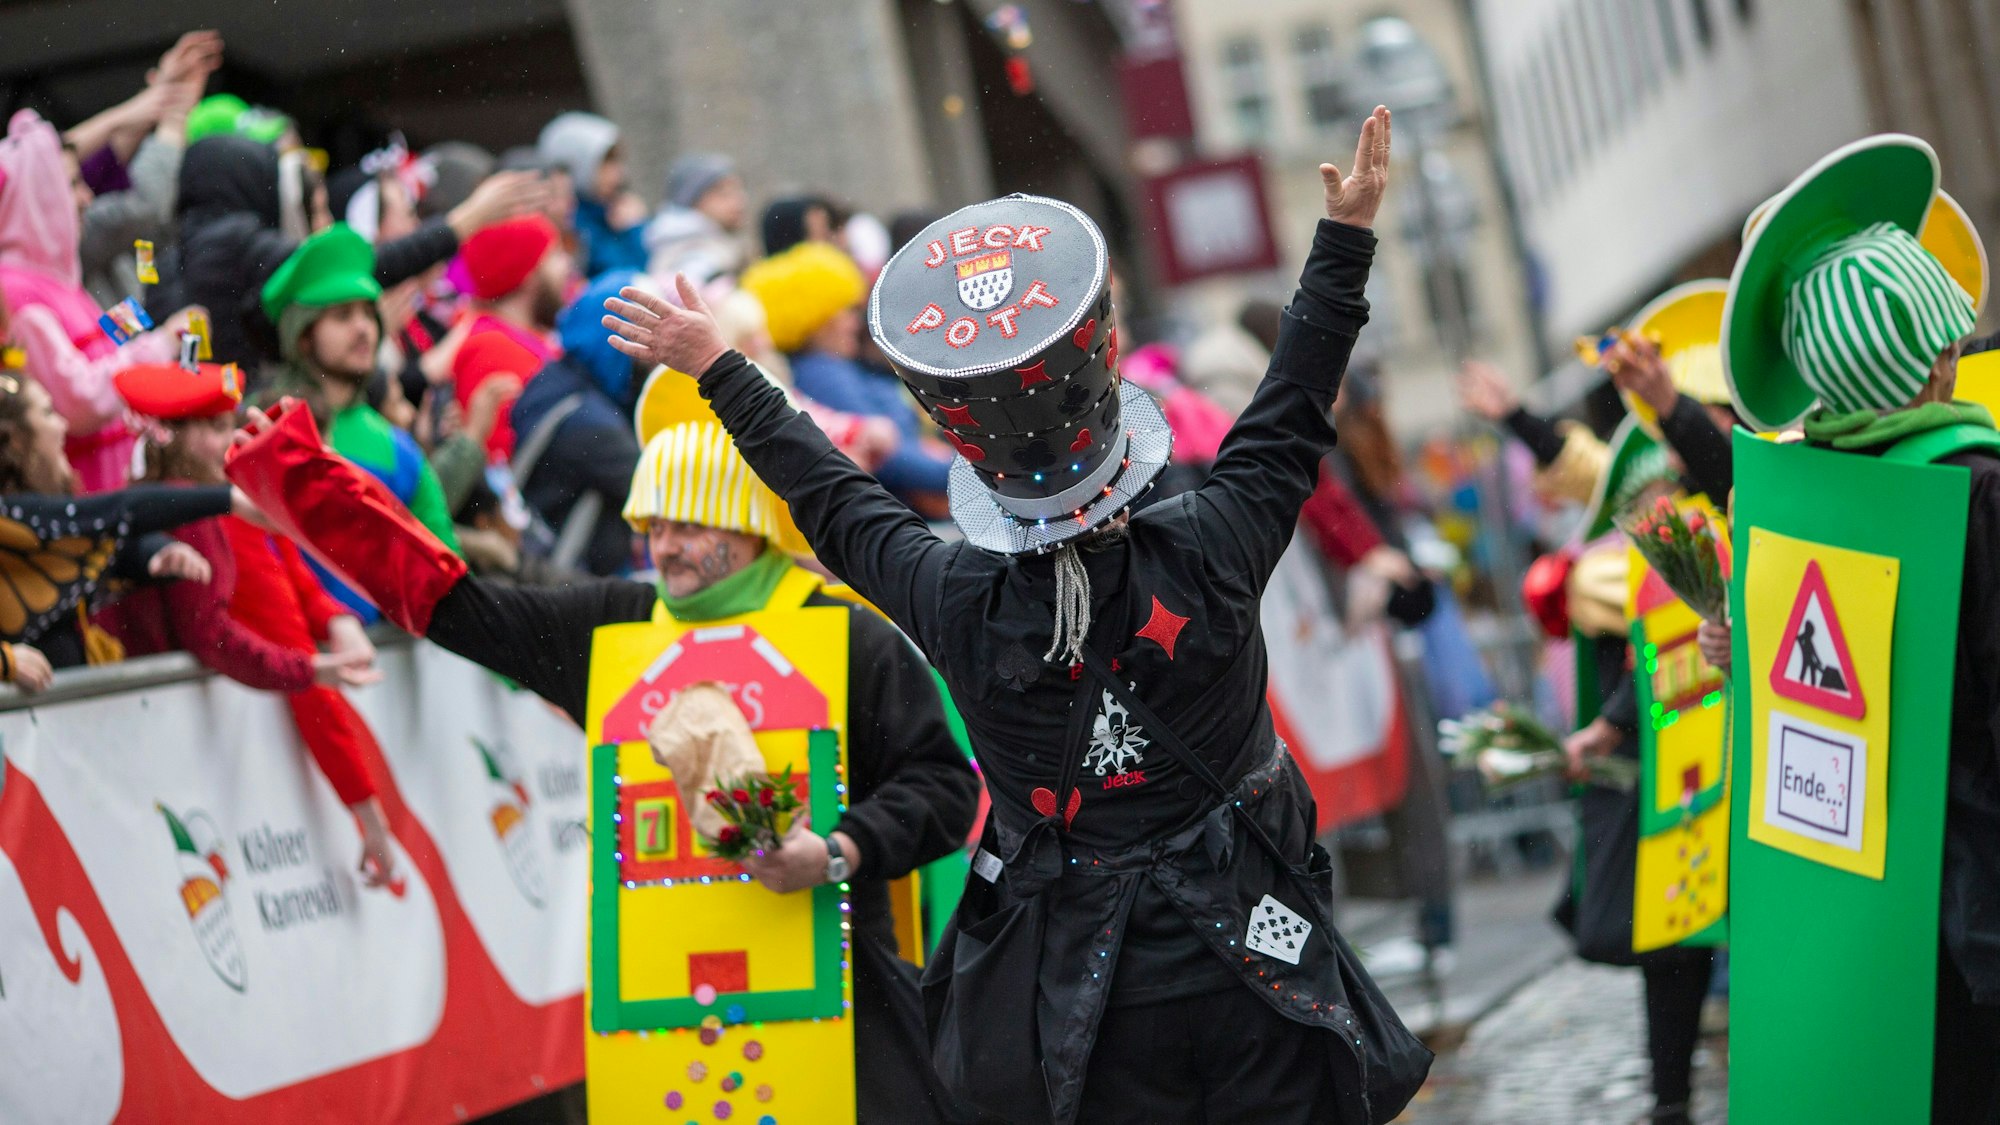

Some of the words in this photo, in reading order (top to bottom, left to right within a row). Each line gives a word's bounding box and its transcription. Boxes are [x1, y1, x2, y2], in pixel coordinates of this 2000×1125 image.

[924, 224, 1051, 268] JECK
[906, 280, 1059, 349] POTT
[1783, 765, 1843, 807] Ende...
[238, 824, 308, 875] Kölner
[641, 808, 660, 848] 7
[254, 868, 342, 930] Karneval
